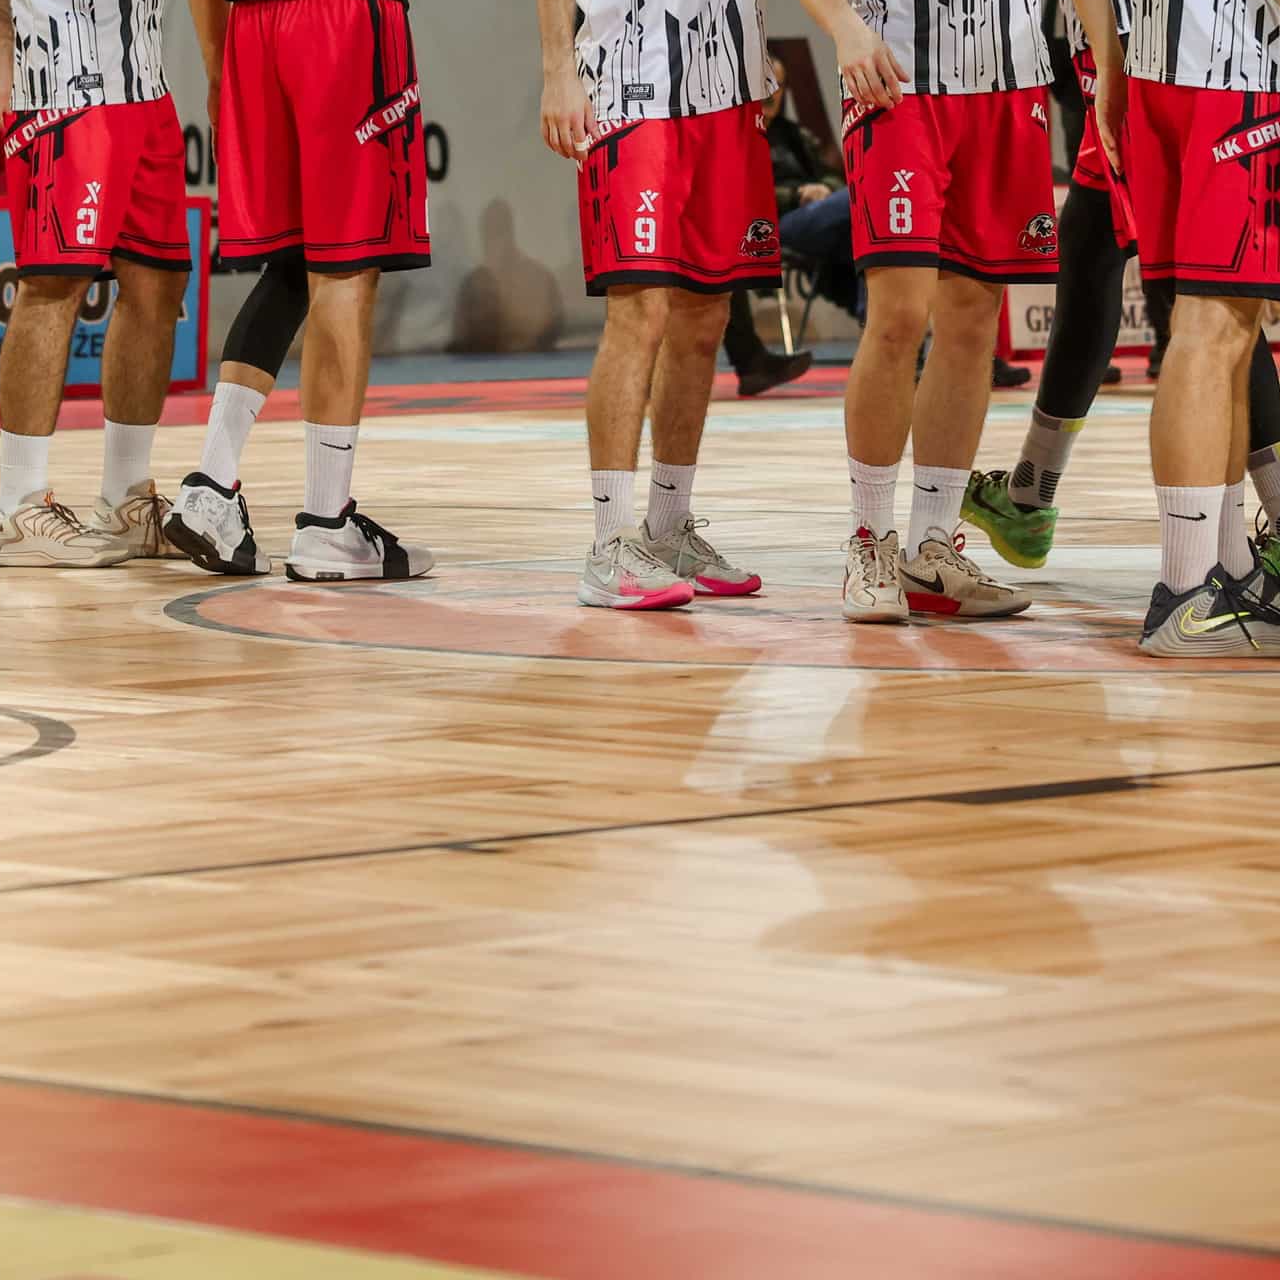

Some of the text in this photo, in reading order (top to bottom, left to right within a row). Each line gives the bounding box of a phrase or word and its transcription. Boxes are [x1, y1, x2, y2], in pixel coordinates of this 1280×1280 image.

[355, 119, 380, 145] KK
[3, 134, 22, 159] KK
[1211, 140, 1242, 163] KK
[889, 197, 913, 234] 8
[634, 217, 656, 253] 9
